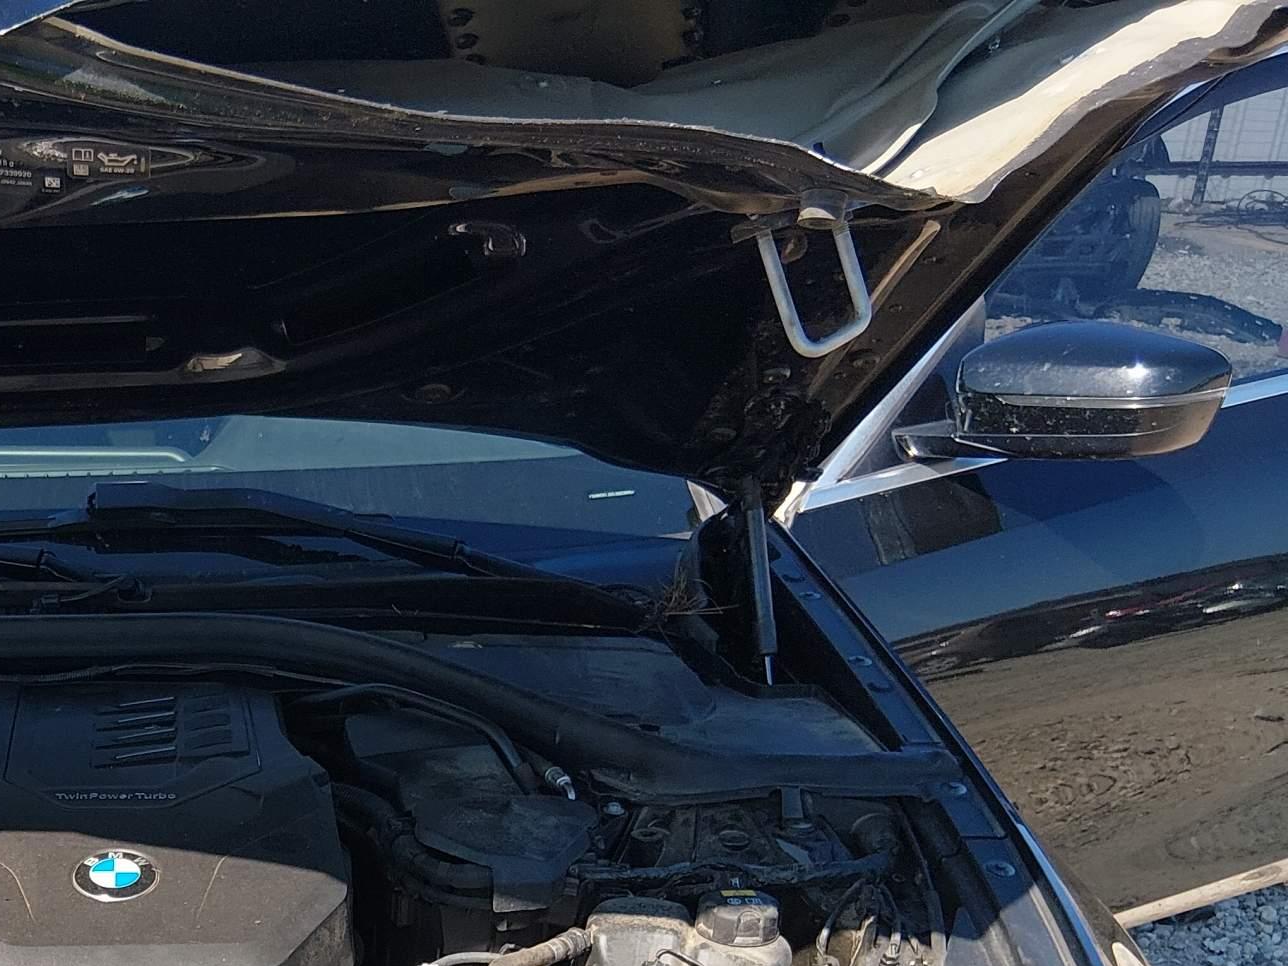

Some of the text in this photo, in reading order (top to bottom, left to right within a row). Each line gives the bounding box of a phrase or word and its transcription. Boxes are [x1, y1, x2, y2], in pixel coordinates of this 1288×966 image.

[99, 166, 112, 174] SAE
[55, 791, 177, 800] TwinPower Turbo
[83, 851, 150, 868] BMW
